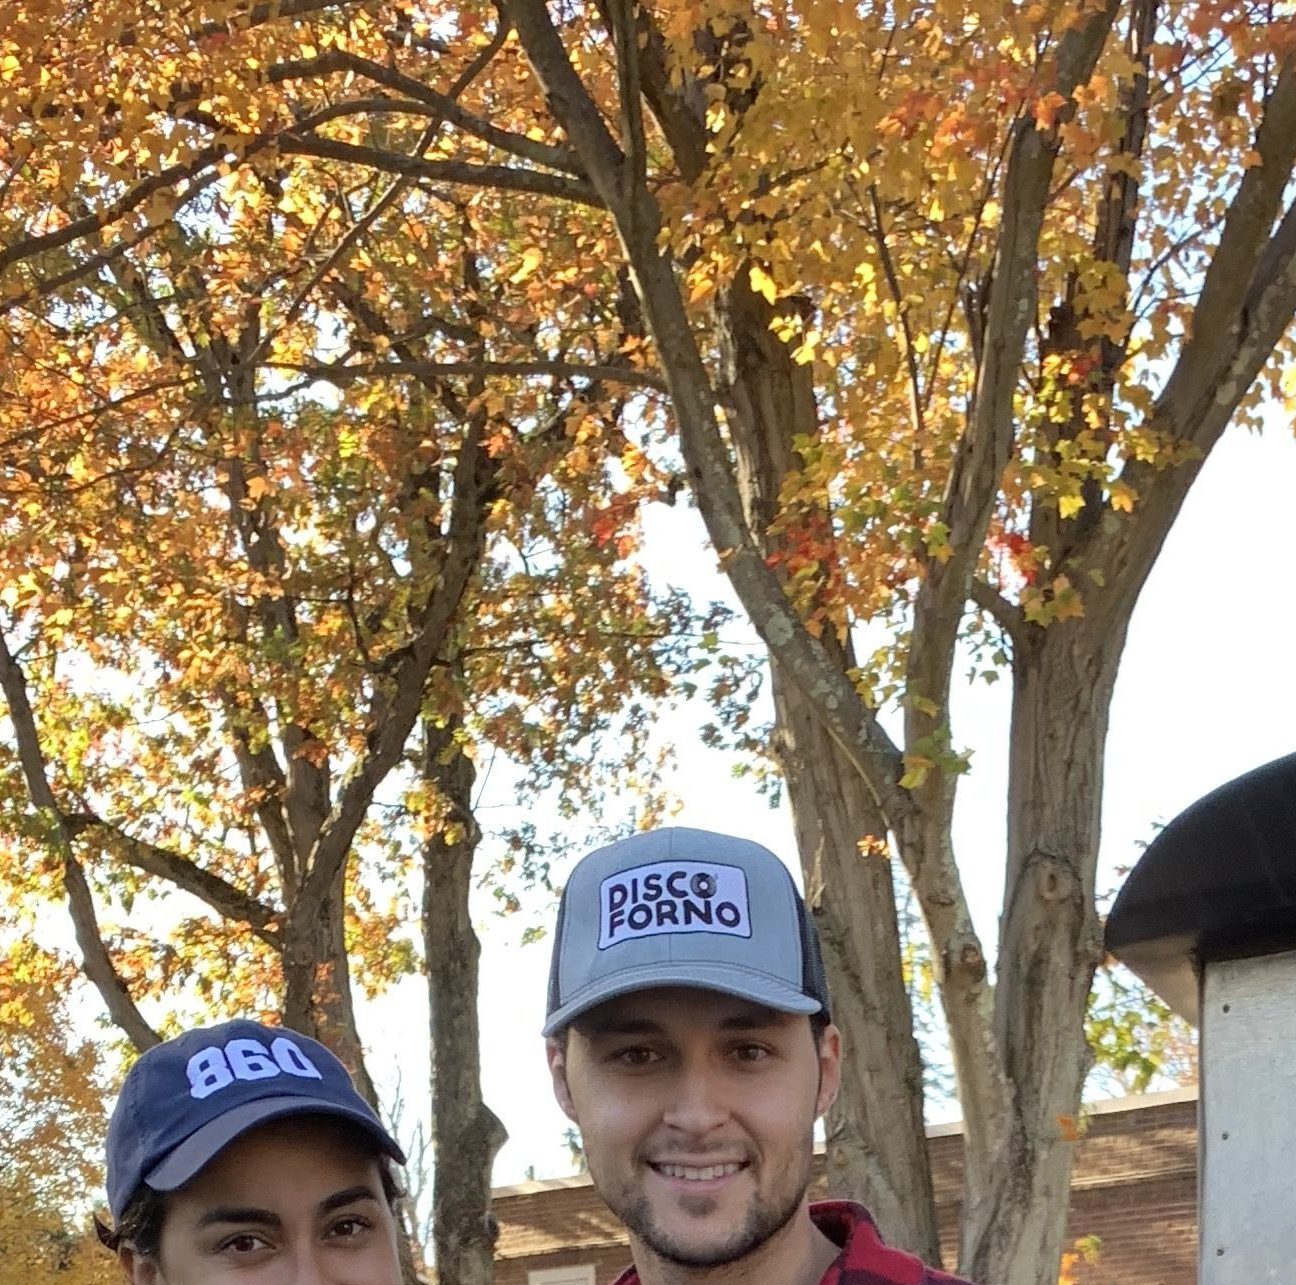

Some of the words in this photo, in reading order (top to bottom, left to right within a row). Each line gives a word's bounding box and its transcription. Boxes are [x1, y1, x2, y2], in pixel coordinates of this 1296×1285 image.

[609, 871, 717, 914] DISCO
[609, 899, 741, 938] FORNO
[186, 1037, 322, 1099] 860
